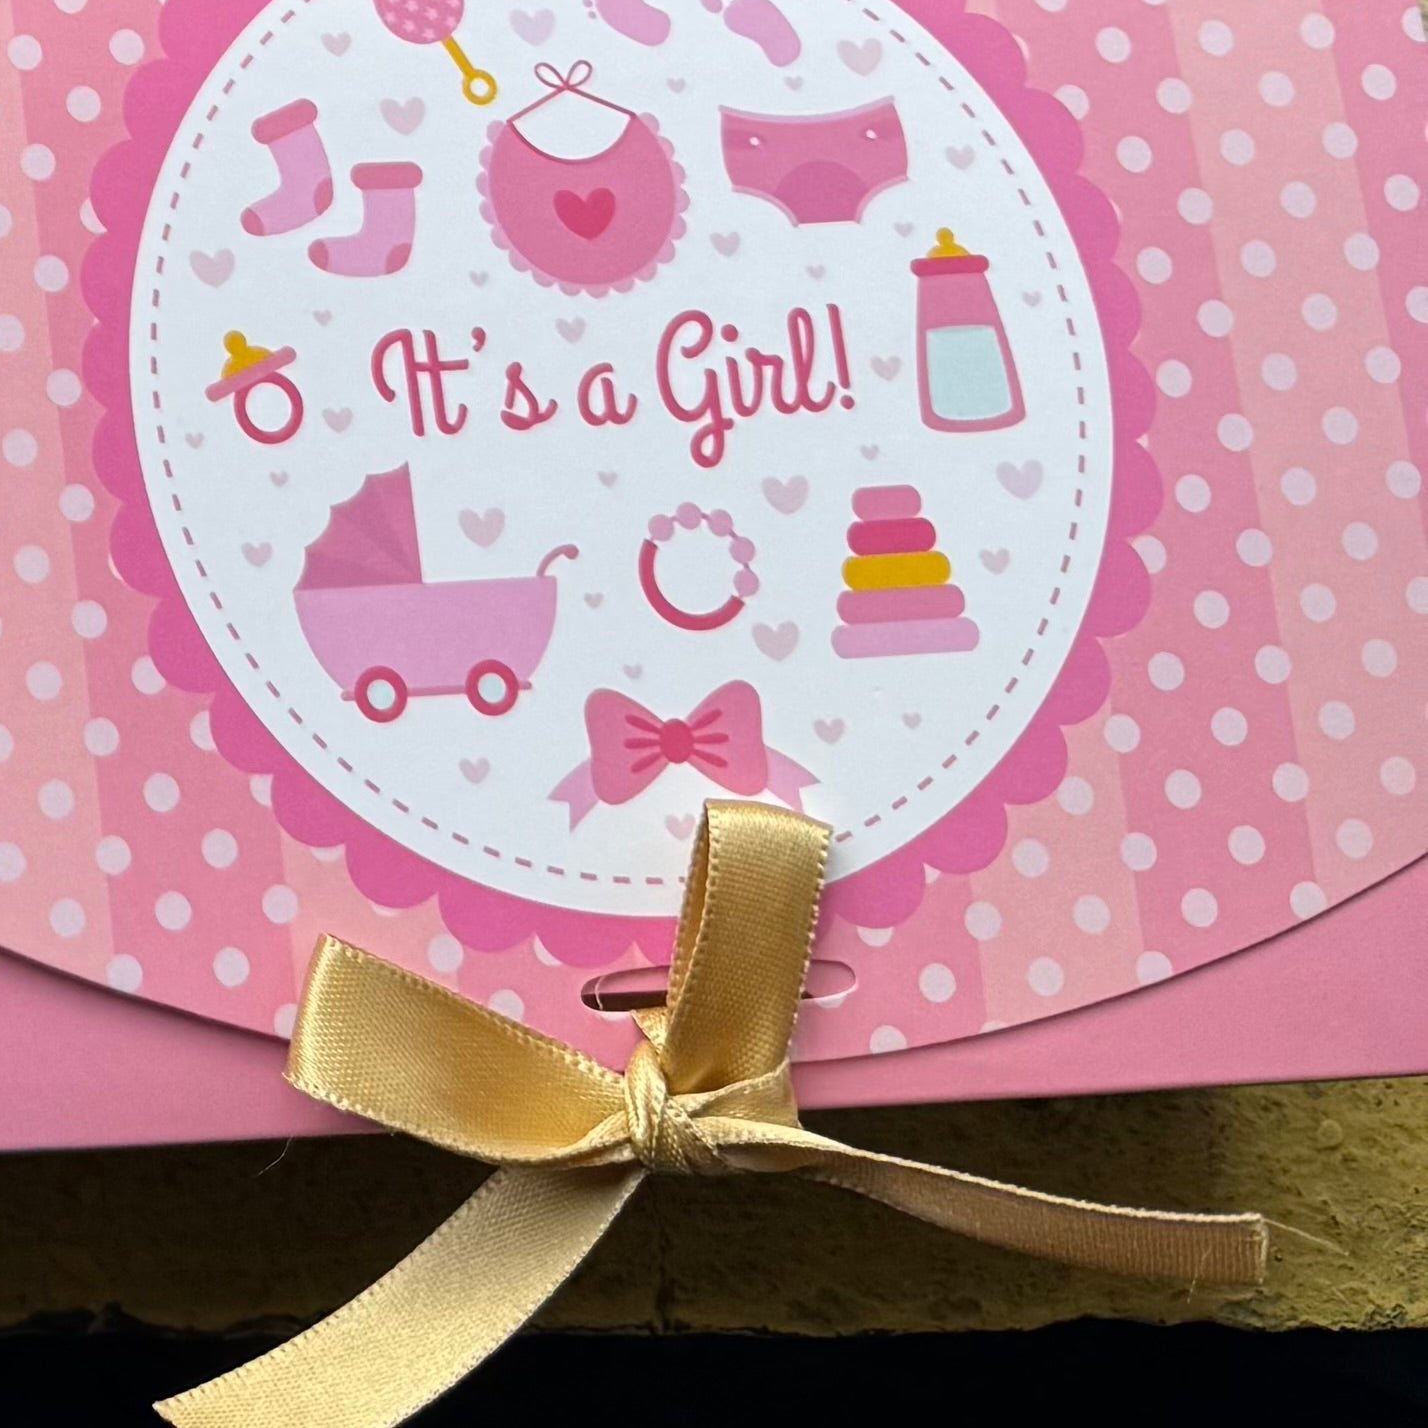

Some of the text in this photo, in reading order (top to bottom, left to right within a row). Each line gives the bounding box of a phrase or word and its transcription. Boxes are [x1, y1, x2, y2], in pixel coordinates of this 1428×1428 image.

[370, 303, 855, 468] It's a Girl!
